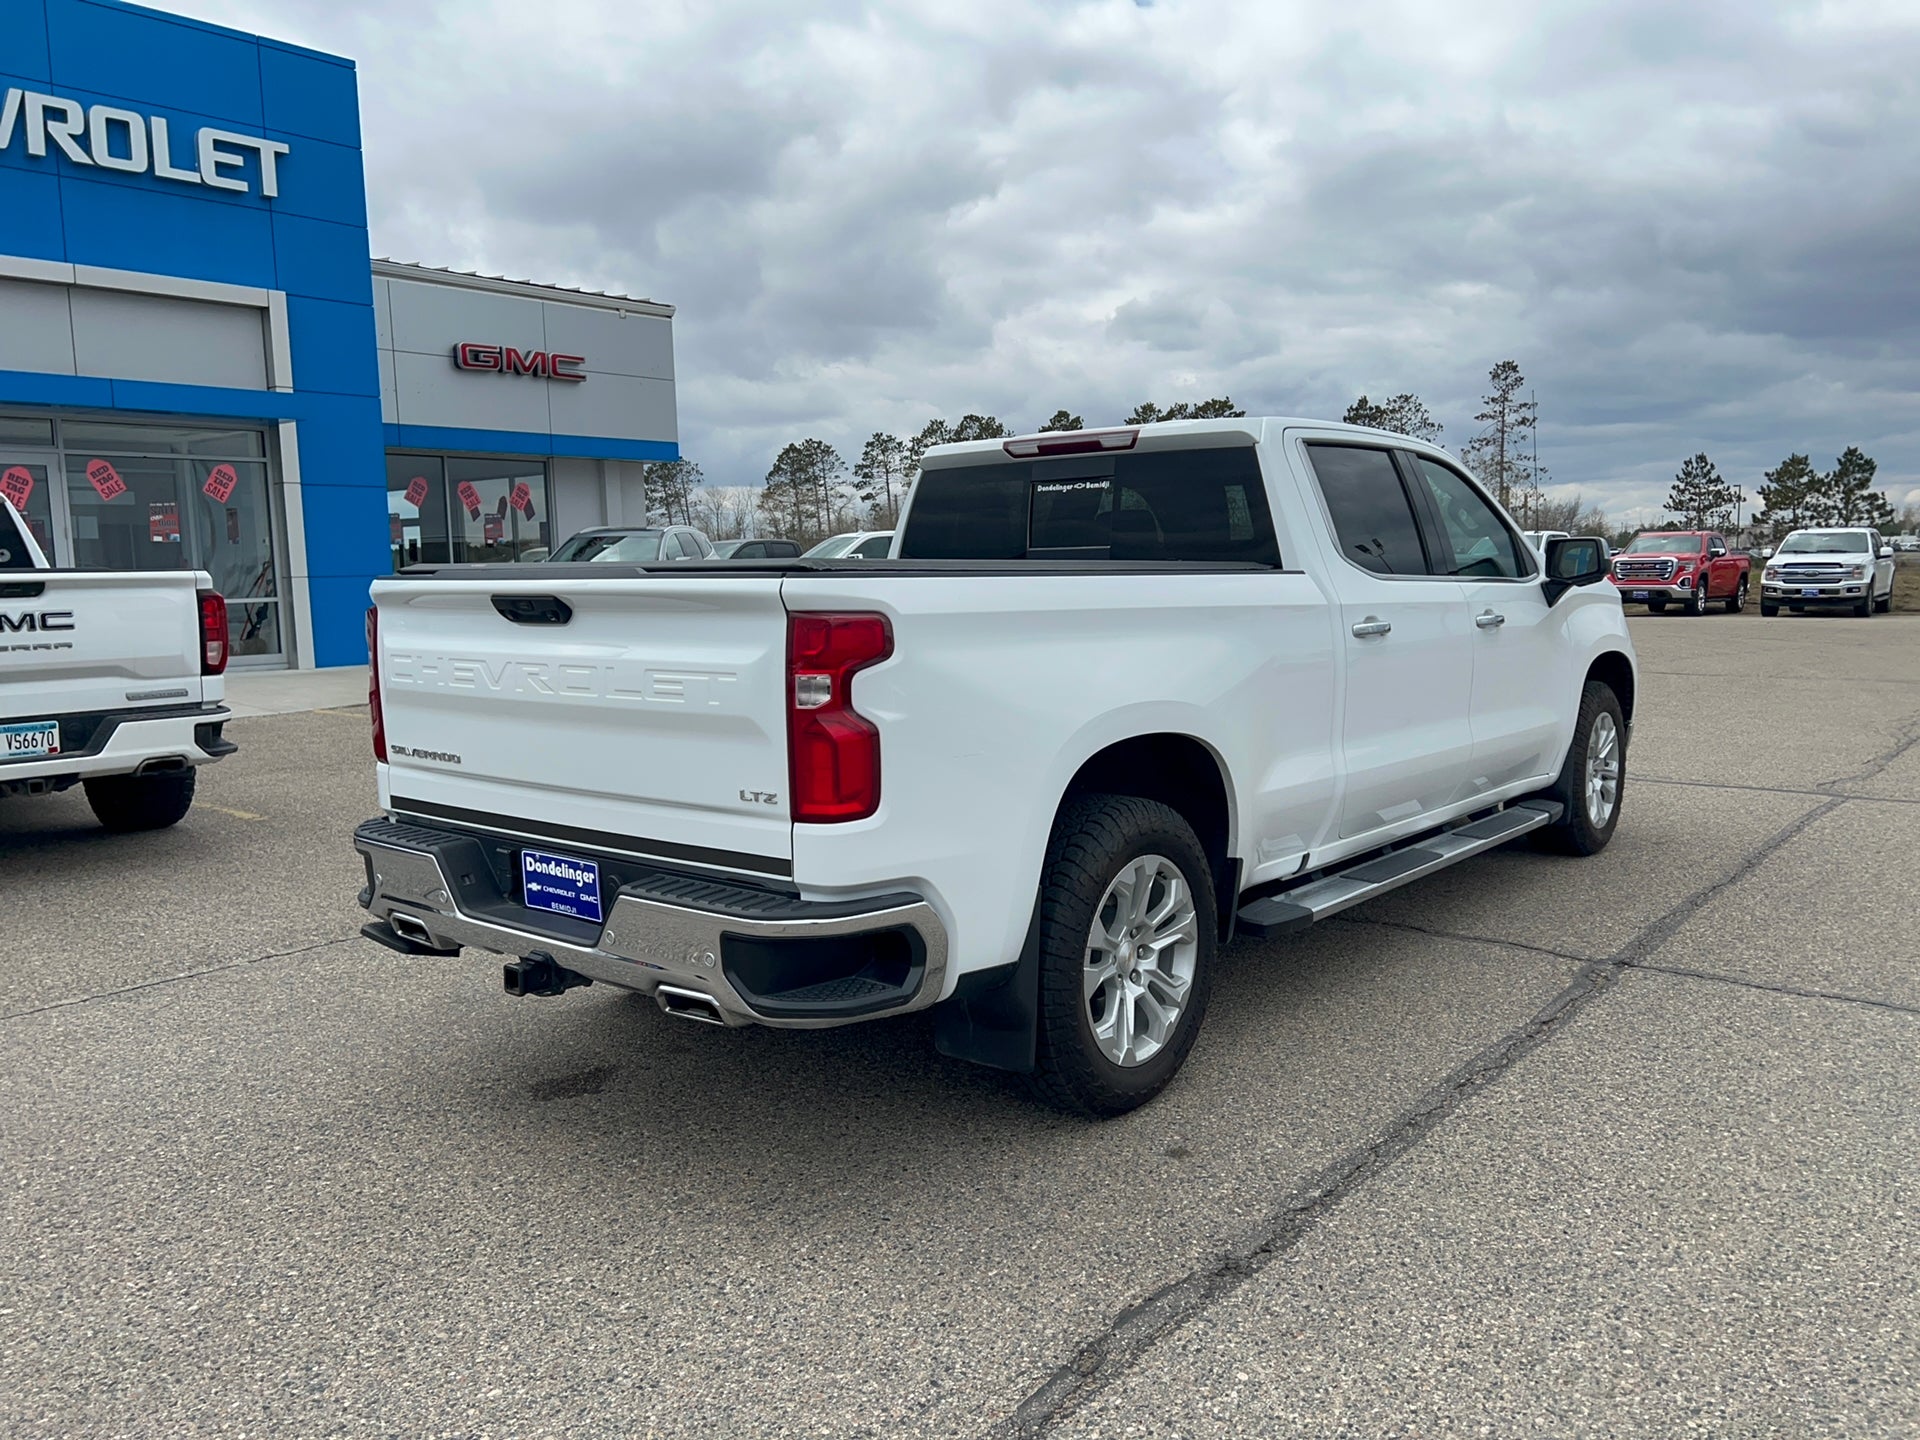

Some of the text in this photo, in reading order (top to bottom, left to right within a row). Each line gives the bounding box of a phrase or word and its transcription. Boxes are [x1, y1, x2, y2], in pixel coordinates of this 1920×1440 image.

[454, 342, 587, 383] GMC
[7, 472, 29, 486] RED
[90, 465, 109, 479] RED
[96, 473, 114, 486] TAG
[216, 469, 233, 483] RED
[6, 481, 25, 494] TAG
[100, 479, 125, 499] SALE
[213, 476, 230, 489] TAG
[1037, 480, 1110, 493] Dondelinger Bemidji
[205, 483, 228, 502] SALE
[390, 653, 738, 705] CHEVROLET
[5, 730, 55, 751] VS6670
[390, 744, 462, 764] SILVERADO
[739, 789, 778, 805] LTZ
[525, 856, 595, 888] Dondelinger
[543, 885, 598, 904] CHEVROLET GMC
[551, 901, 577, 914] BEMIDJI
